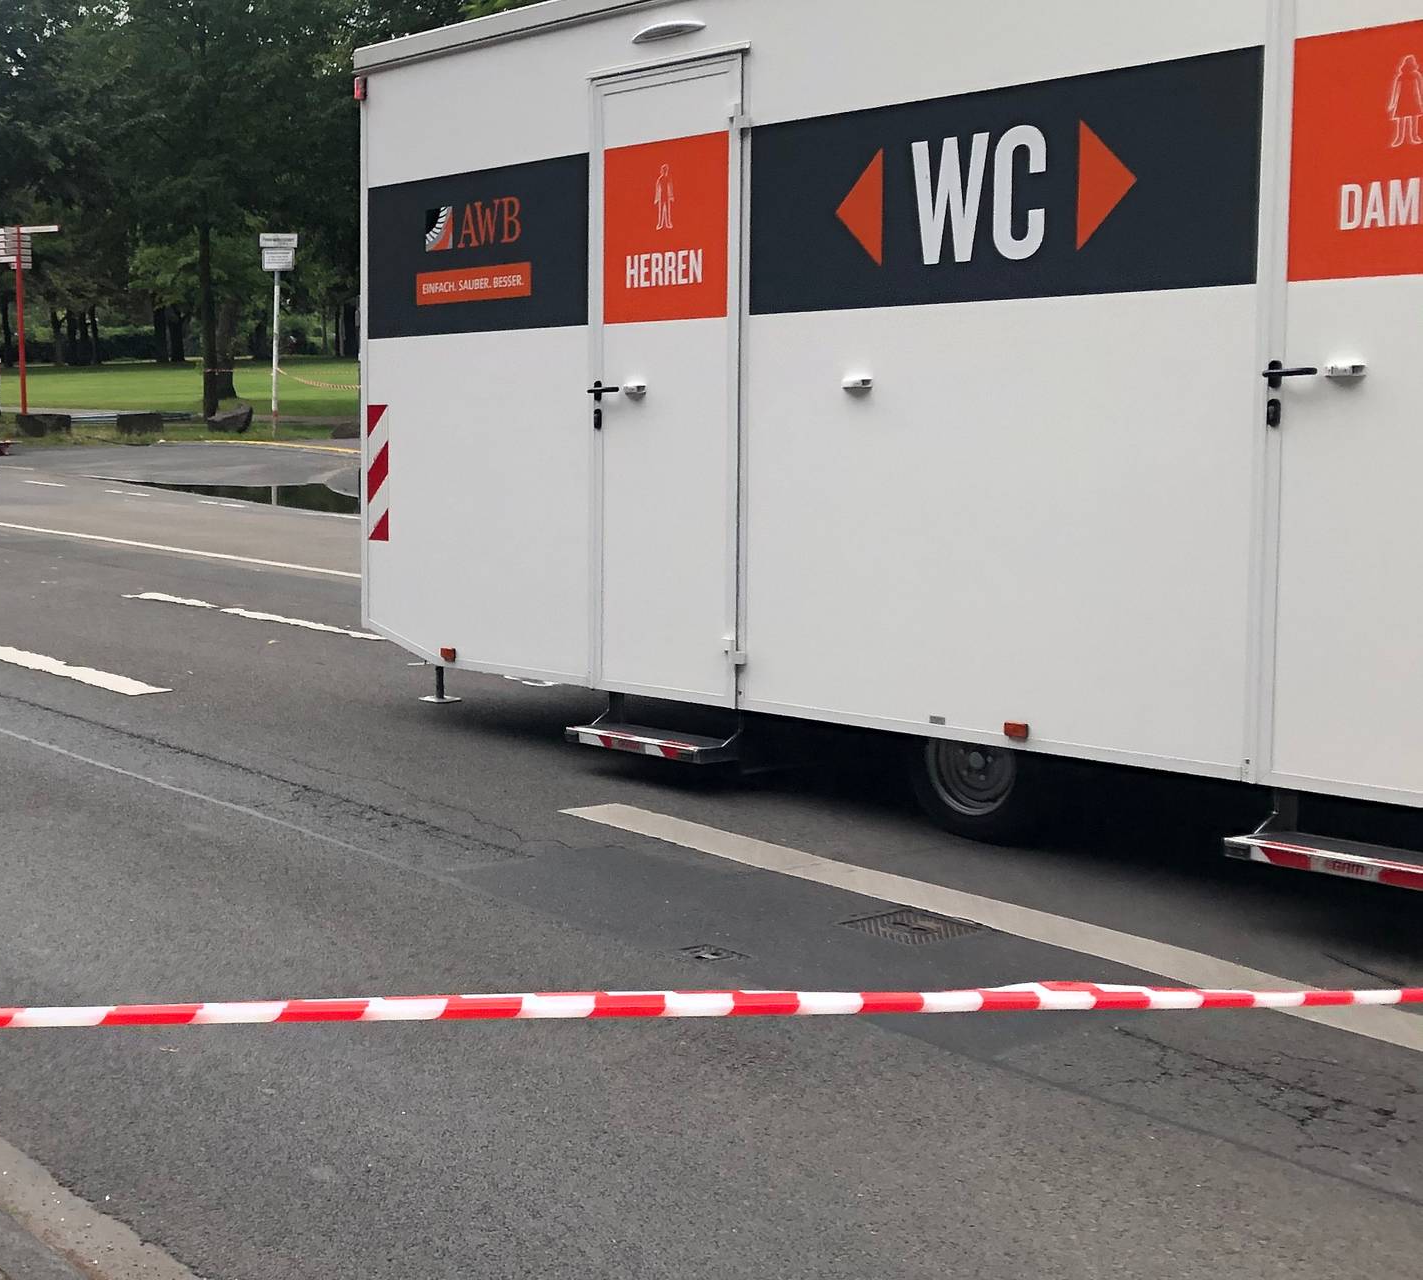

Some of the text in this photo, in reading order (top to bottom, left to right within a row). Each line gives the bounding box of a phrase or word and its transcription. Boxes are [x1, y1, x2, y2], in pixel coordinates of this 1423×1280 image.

[911, 124, 1047, 265] WC
[1339, 177, 1423, 231] DAM
[457, 196, 522, 249] AWB
[422, 274, 525, 295] EINFACH. SAUBER. BESSER.
[625, 248, 703, 289] HERREN
